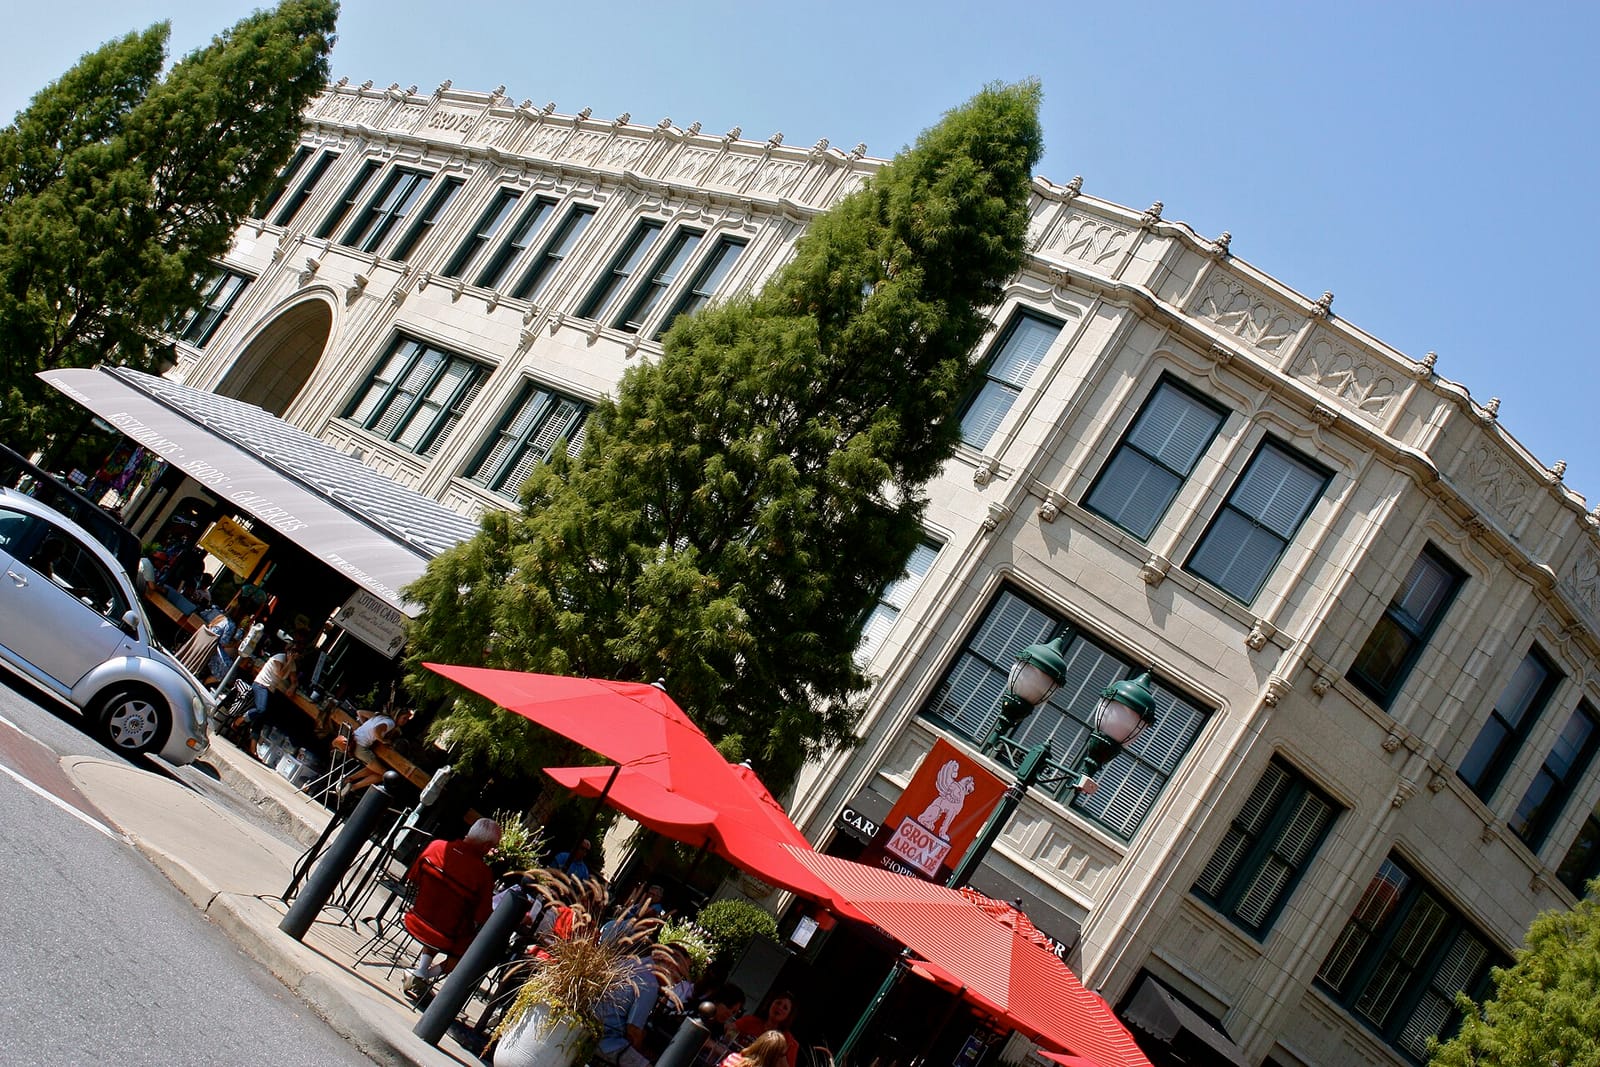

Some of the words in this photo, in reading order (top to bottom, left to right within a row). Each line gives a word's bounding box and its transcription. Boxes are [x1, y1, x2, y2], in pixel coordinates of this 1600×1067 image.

[428, 111, 477, 133] GROVE
[182, 460, 232, 485] SHOPS
[231, 490, 308, 532] GALLERIES
[842, 809, 880, 838] CAR
[890, 837, 937, 872] ARCADE
[900, 823, 946, 860] GROVE
